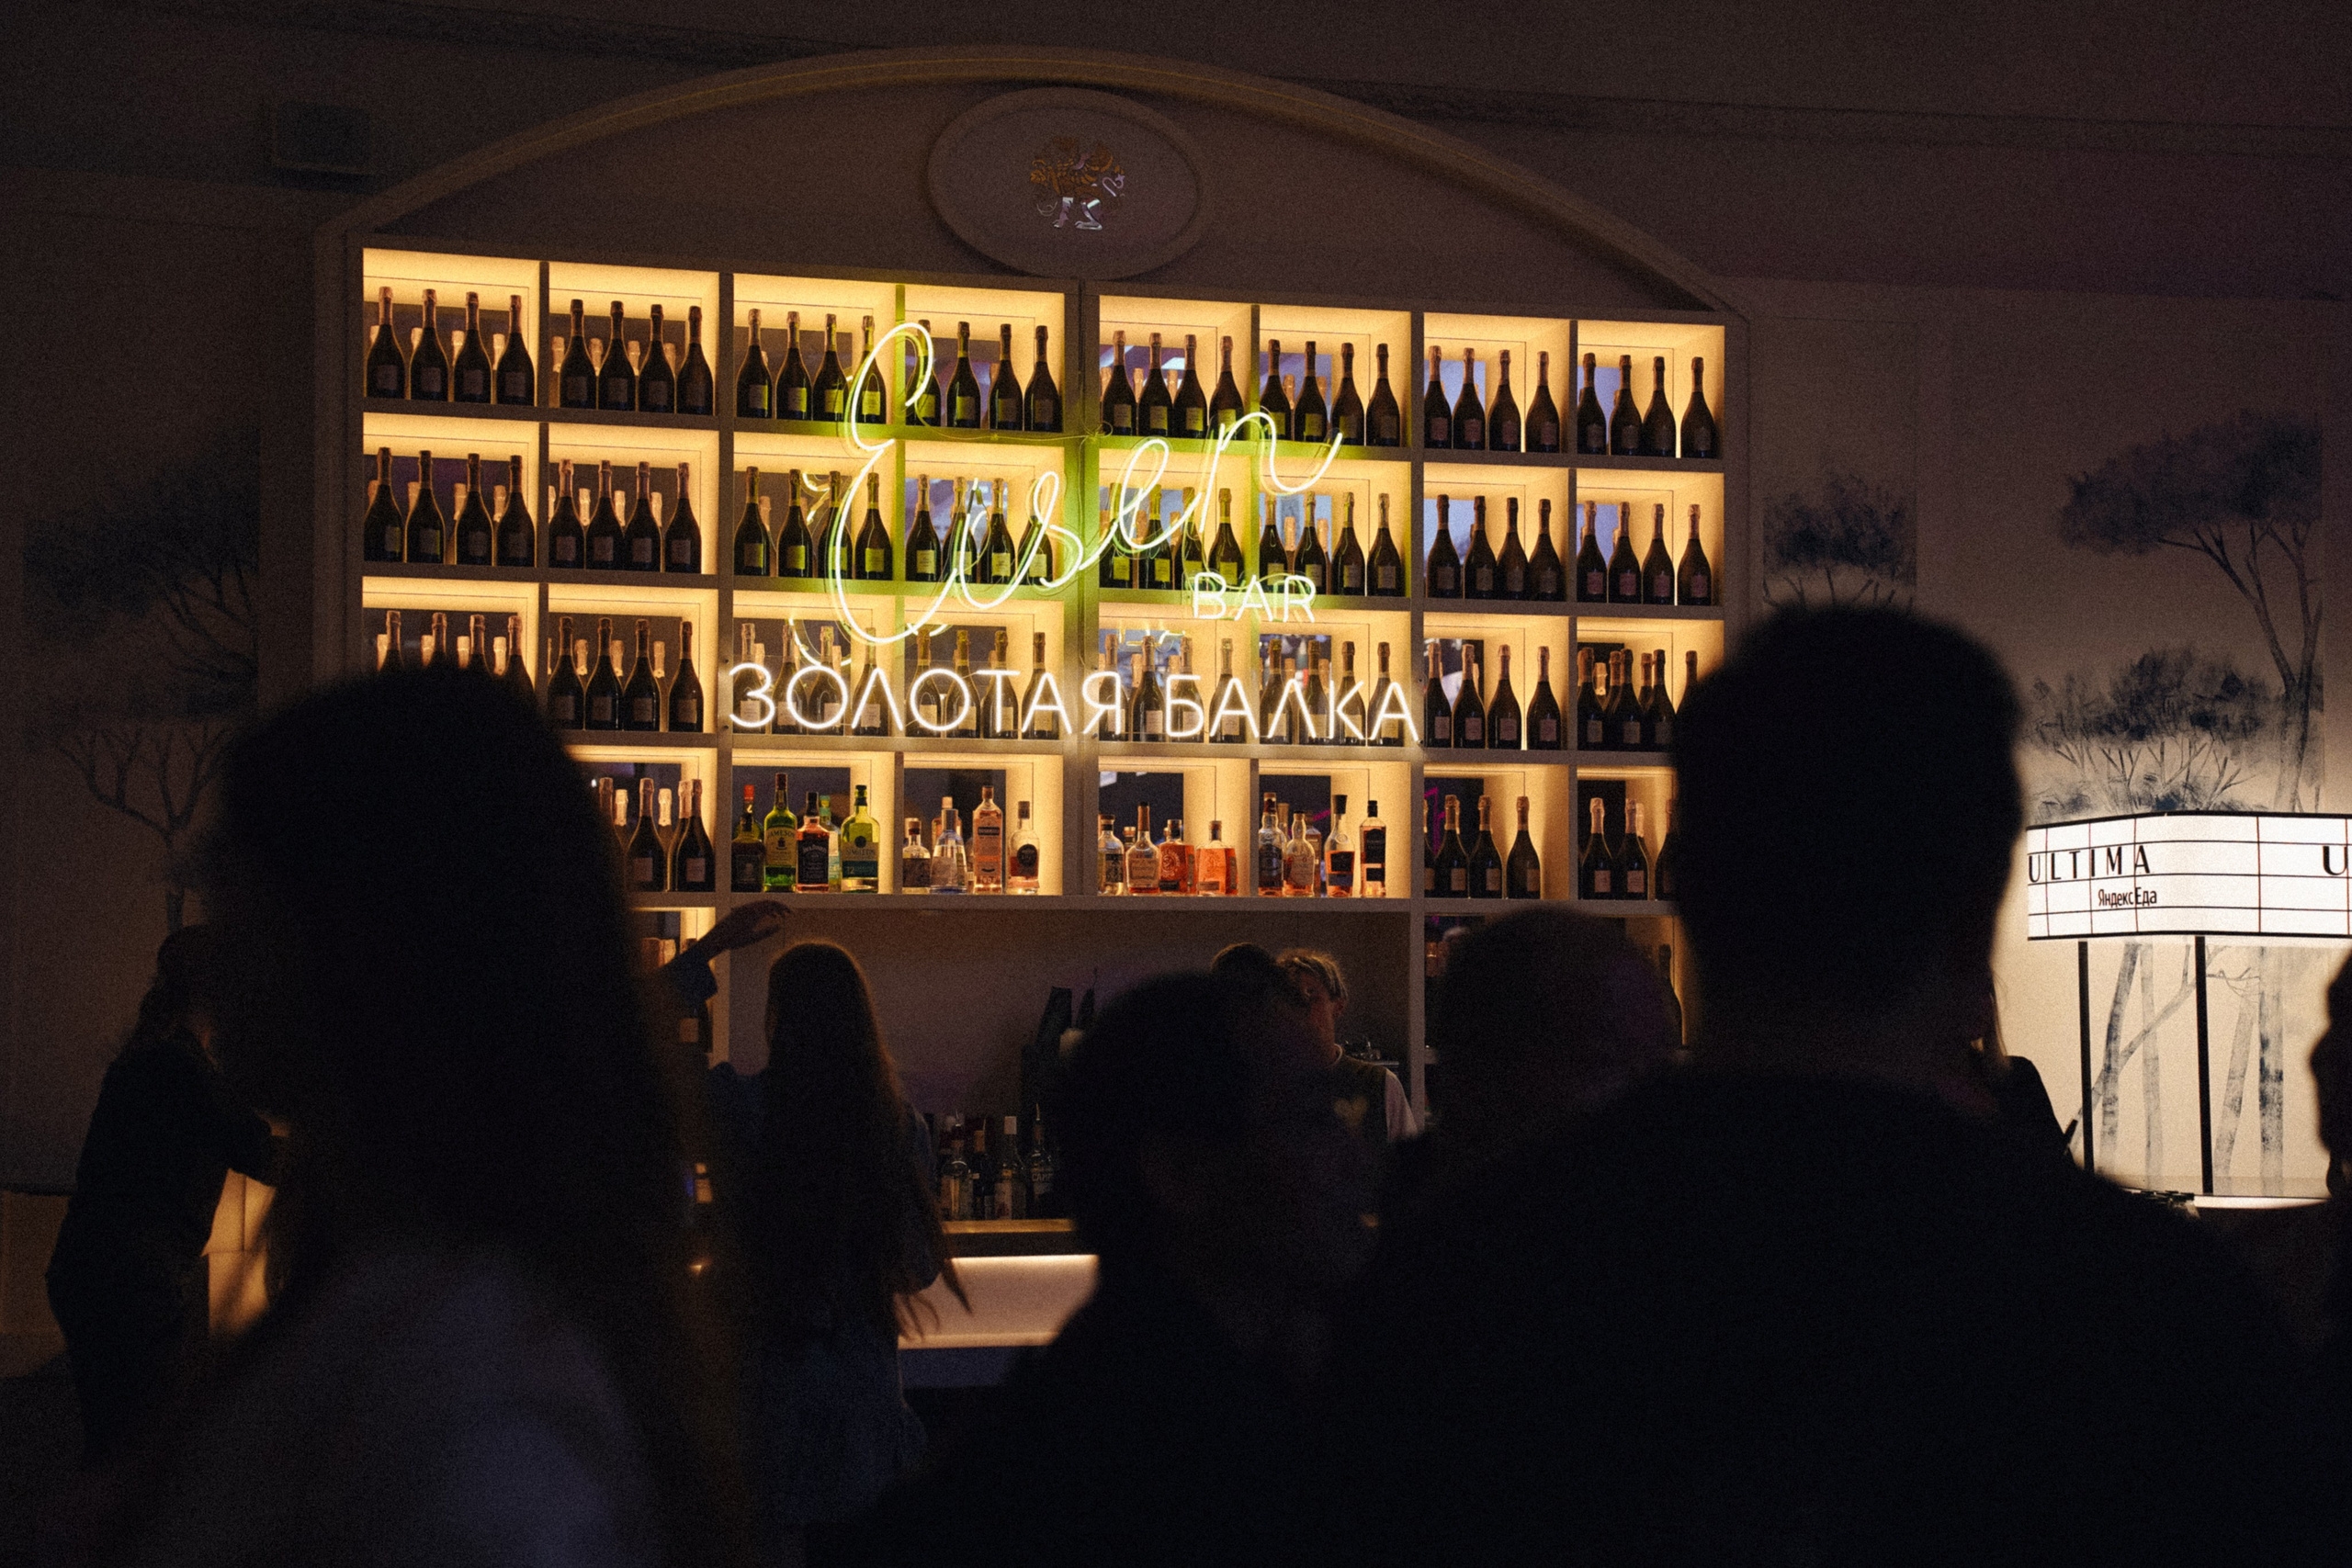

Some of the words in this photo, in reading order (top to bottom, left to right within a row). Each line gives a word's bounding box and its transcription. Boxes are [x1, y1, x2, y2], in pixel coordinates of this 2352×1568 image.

[1194, 571, 1316, 623] BAR
[729, 662, 1122, 736] ЗОЛОТАЯ
[1165, 673, 1419, 742] БАЛКА
[2028, 844, 2151, 883] ULTIMA
[2098, 888, 2134, 908] Яндекс
